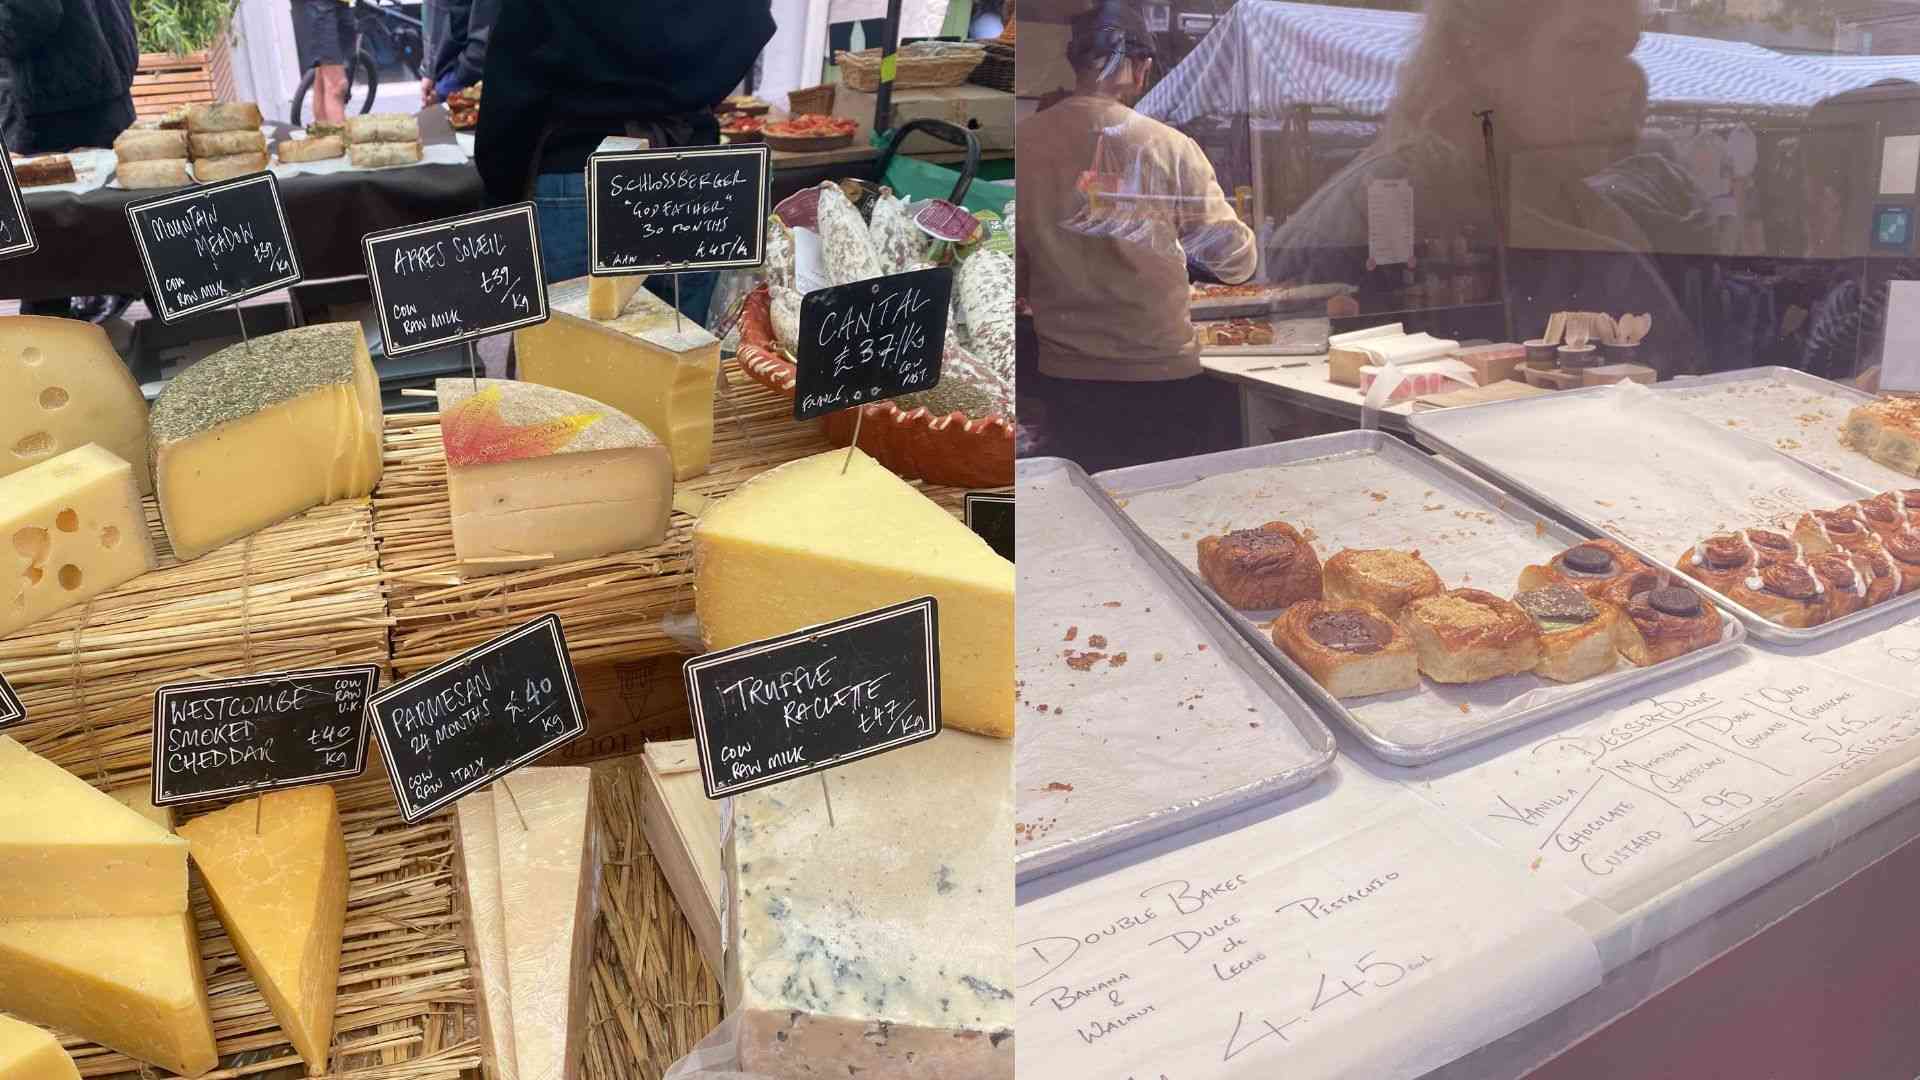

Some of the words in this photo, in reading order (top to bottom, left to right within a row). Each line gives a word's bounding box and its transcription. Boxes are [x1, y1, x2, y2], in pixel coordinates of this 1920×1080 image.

[151, 204, 219, 242] MOUNTAIN
[194, 222, 255, 260] MEADOW
[641, 223, 664, 238] 30
[394, 241, 446, 277] APRES
[452, 233, 507, 263] SOLEIL
[176, 291, 199, 307] RAW
[200, 280, 229, 300] MILK
[393, 303, 418, 320] COW
[402, 318, 428, 336] RAW
[431, 309, 464, 330] MILK
[818, 287, 931, 346] CANTAL
[335, 679, 363, 691] COW
[335, 690, 362, 703] RAW
[391, 664, 495, 738] PARMESAN
[722, 655, 838, 711] TRUFFLE
[170, 685, 313, 725] WESTCOMBE
[168, 720, 258, 752] SMOKED
[410, 733, 433, 755] 24
[435, 699, 491, 745] MONTHS
[168, 738, 277, 776] CHEDDAR
[720, 740, 752, 762] COW
[731, 759, 762, 780] RAW
[767, 745, 807, 770] MILK
[408, 768, 433, 790] COW
[415, 778, 443, 800] RAW
[450, 756, 486, 784] ITALY
[1487, 788, 1579, 827] VANILLA
[1555, 800, 1636, 853] CHOCOLATE
[1580, 829, 1664, 876] CUSTARD
[1274, 872, 1400, 920] PISTACHIO
[1015, 908, 1158, 990] DOUBLE
[1139, 873, 1249, 916] BAKES
[1147, 913, 1242, 954] DULCE
[1029, 971, 1131, 1012] BANANA
[1107, 989, 1125, 1008] &
[1077, 1004, 1157, 1045] WALNUT
